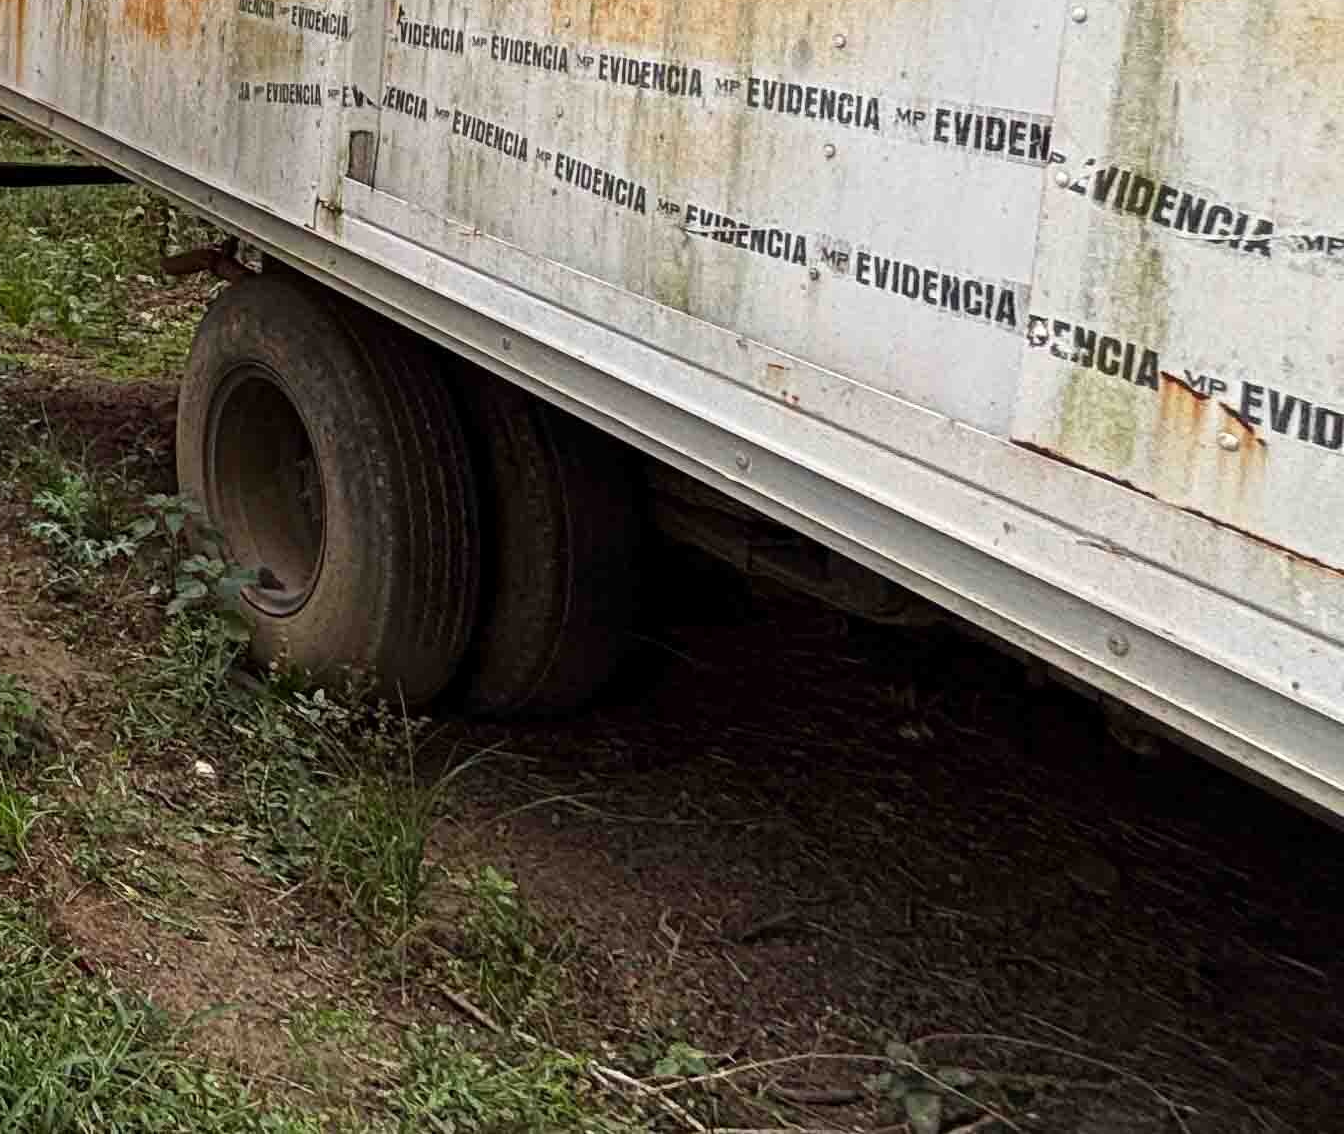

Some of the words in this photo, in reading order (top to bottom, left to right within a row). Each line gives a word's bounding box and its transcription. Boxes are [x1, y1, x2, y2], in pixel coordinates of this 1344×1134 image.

[291, 5, 350, 40] EVIDENCIA
[491, 35, 569, 74] EVIDENCIA
[598, 54, 702, 98] EVIDENCIA
[746, 77, 880, 130] EVIDENCIA
[895, 107, 926, 126] MP
[266, 82, 322, 106] EVIDENCIA
[452, 109, 528, 162] EVIDENCIA
[554, 153, 646, 215] EVIDENCIA
[656, 197, 681, 216] MP
[856, 251, 1017, 327] EVIDENCIA
